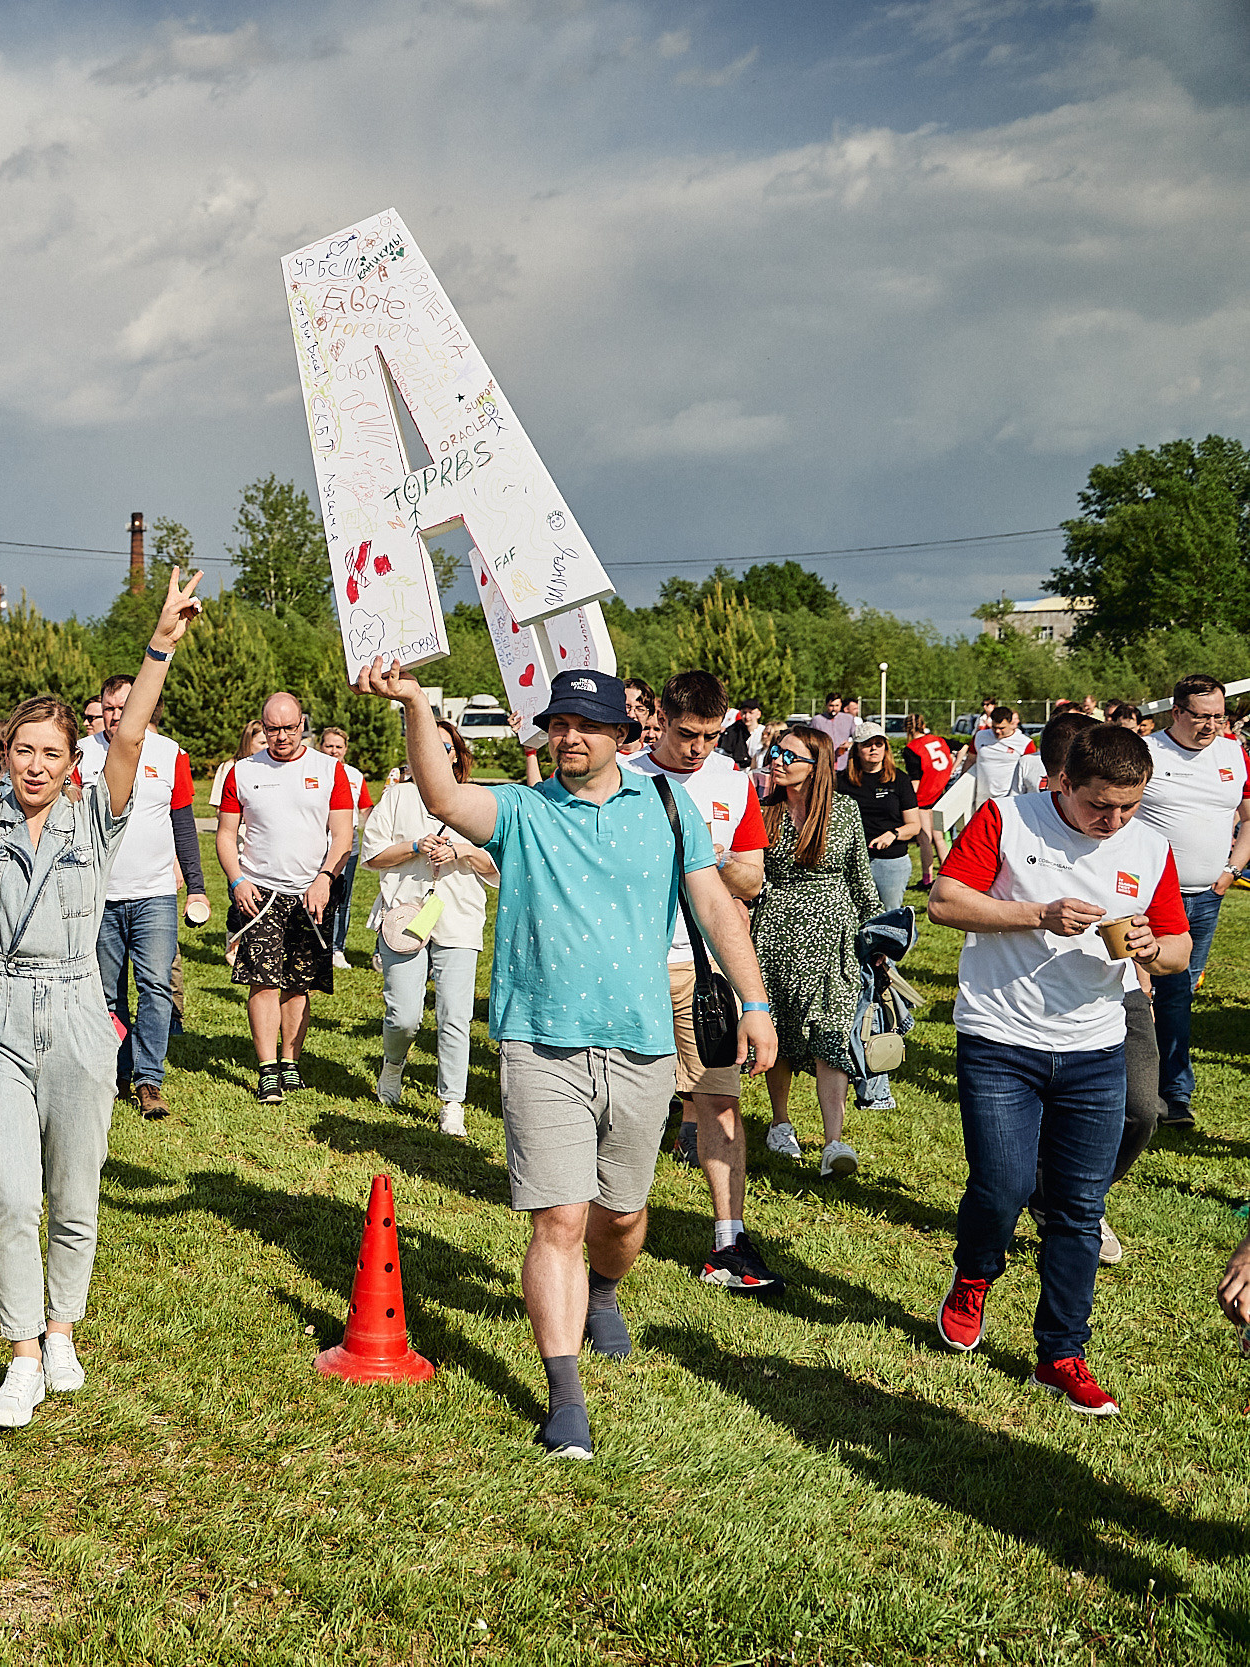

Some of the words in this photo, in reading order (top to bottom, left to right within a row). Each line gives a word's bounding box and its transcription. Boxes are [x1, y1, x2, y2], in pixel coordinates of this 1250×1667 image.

[357, 233, 403, 280] КАНИКУЛЫ
[399, 258, 471, 359] ИЗОЛЕНТА
[335, 354, 375, 382] СКБТ
[312, 396, 335, 451] СКБТ
[439, 413, 490, 452] ORACLE
[494, 545, 517, 572] FAF
[924, 740, 950, 772] 5
